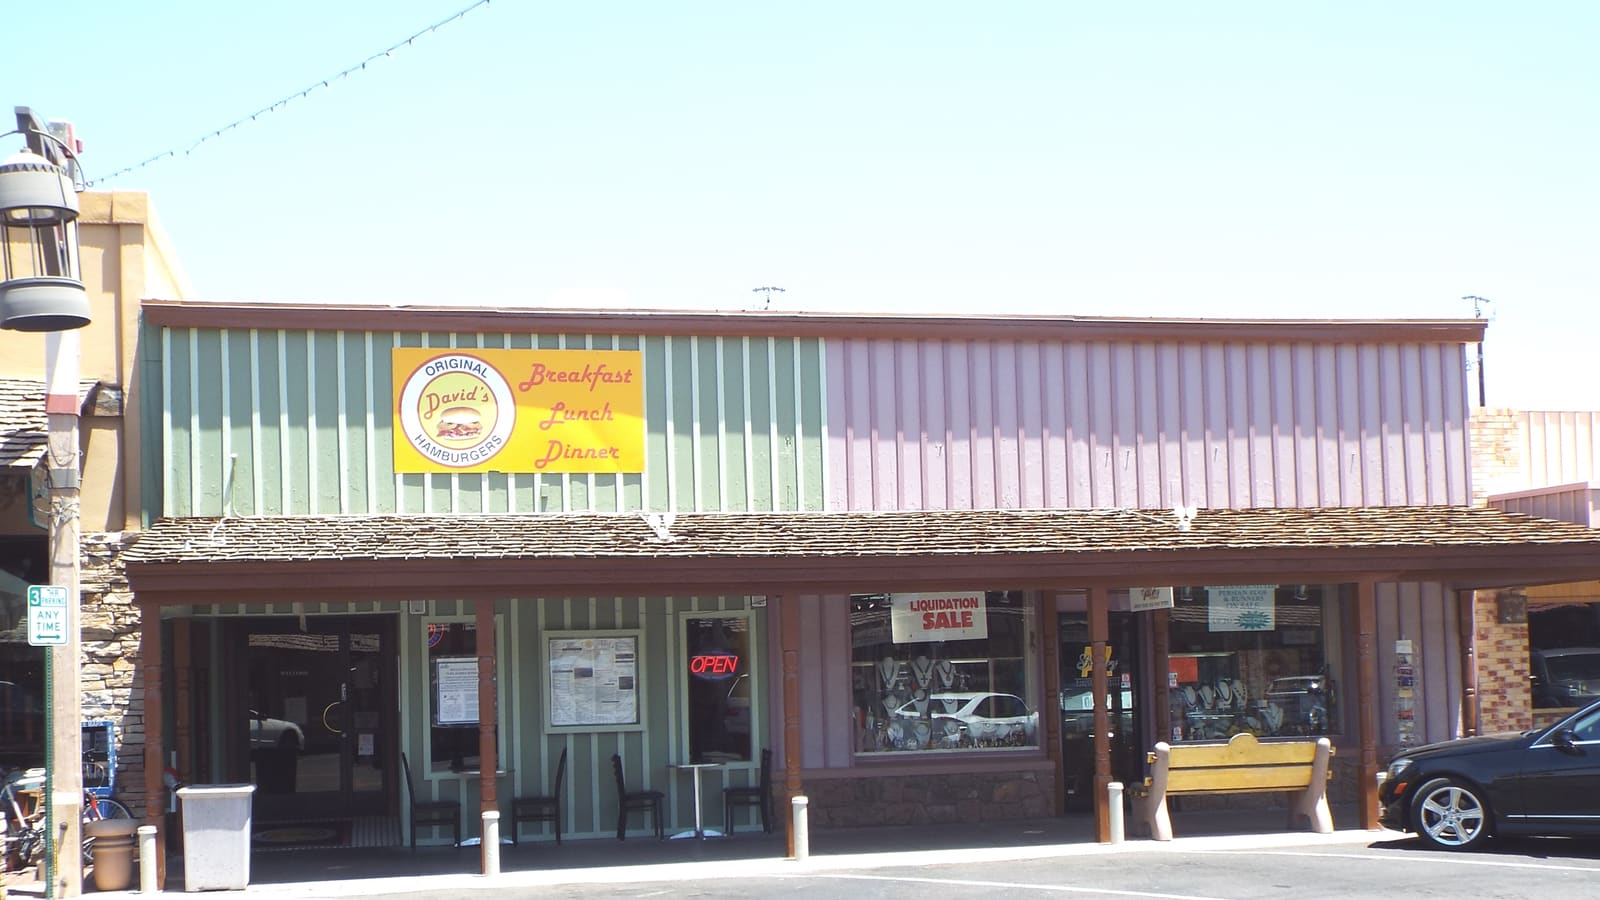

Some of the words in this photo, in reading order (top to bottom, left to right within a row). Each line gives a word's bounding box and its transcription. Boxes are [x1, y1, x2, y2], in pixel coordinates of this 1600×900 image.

[425, 358, 489, 379] ORIGINAL
[518, 363, 632, 392] Breakfast
[423, 387, 489, 420] David's
[539, 401, 614, 431] Lunch
[414, 434, 502, 463] HAMBURGERS
[534, 439, 620, 469] Dinner
[31, 590, 40, 605] 3
[910, 598, 979, 612] LIQUIDATION
[37, 611, 59, 619] ANY
[922, 611, 973, 630] SALE
[36, 622, 61, 631] TIME
[690, 655, 738, 673] OPEN
